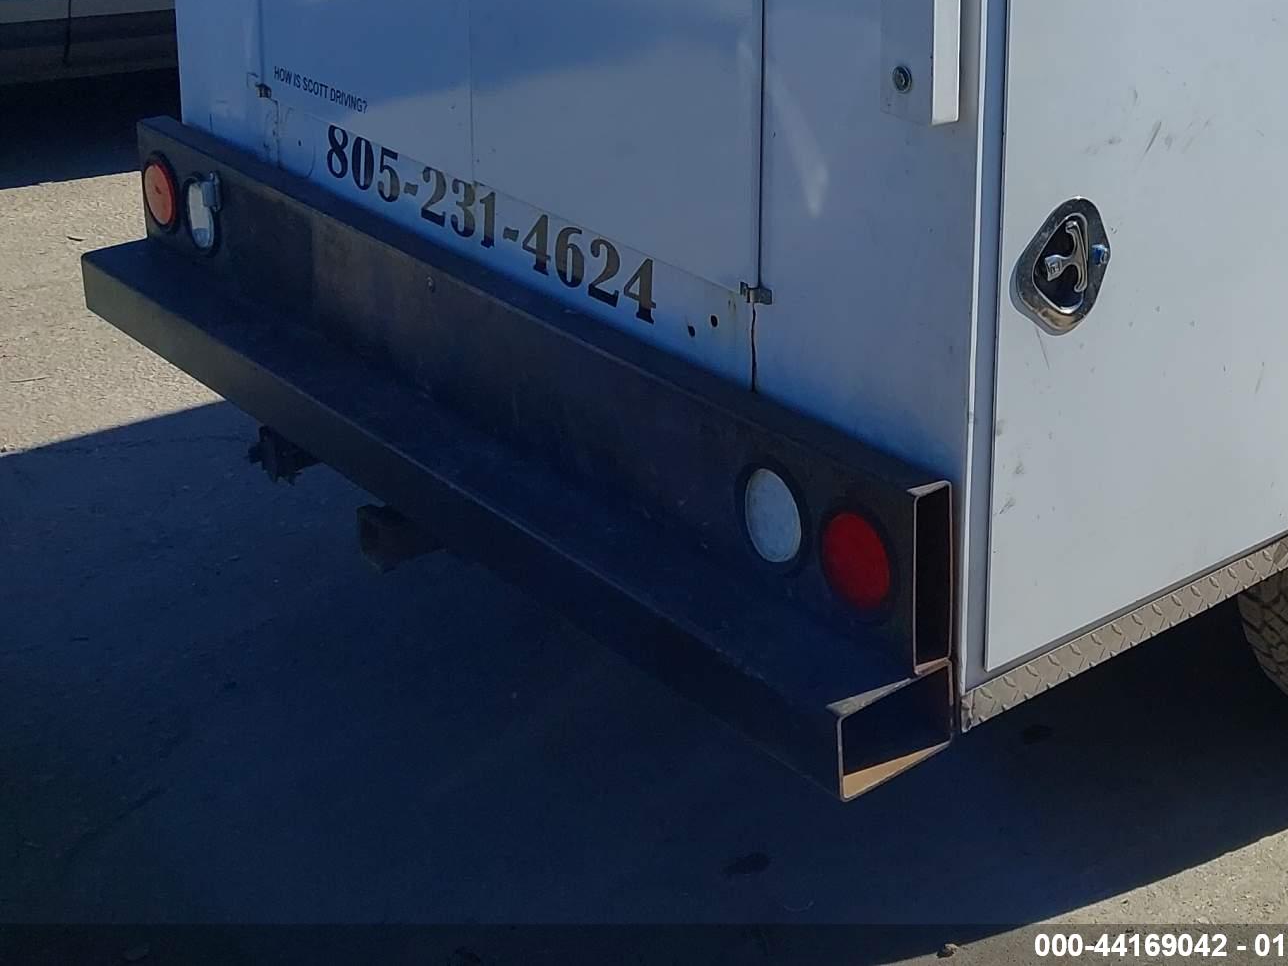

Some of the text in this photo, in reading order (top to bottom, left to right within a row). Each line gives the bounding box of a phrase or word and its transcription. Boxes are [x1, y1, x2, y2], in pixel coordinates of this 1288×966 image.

[274, 65, 368, 114] HOW IS SCOTT DRIVING?
[326, 123, 657, 325] 805-231-4624
